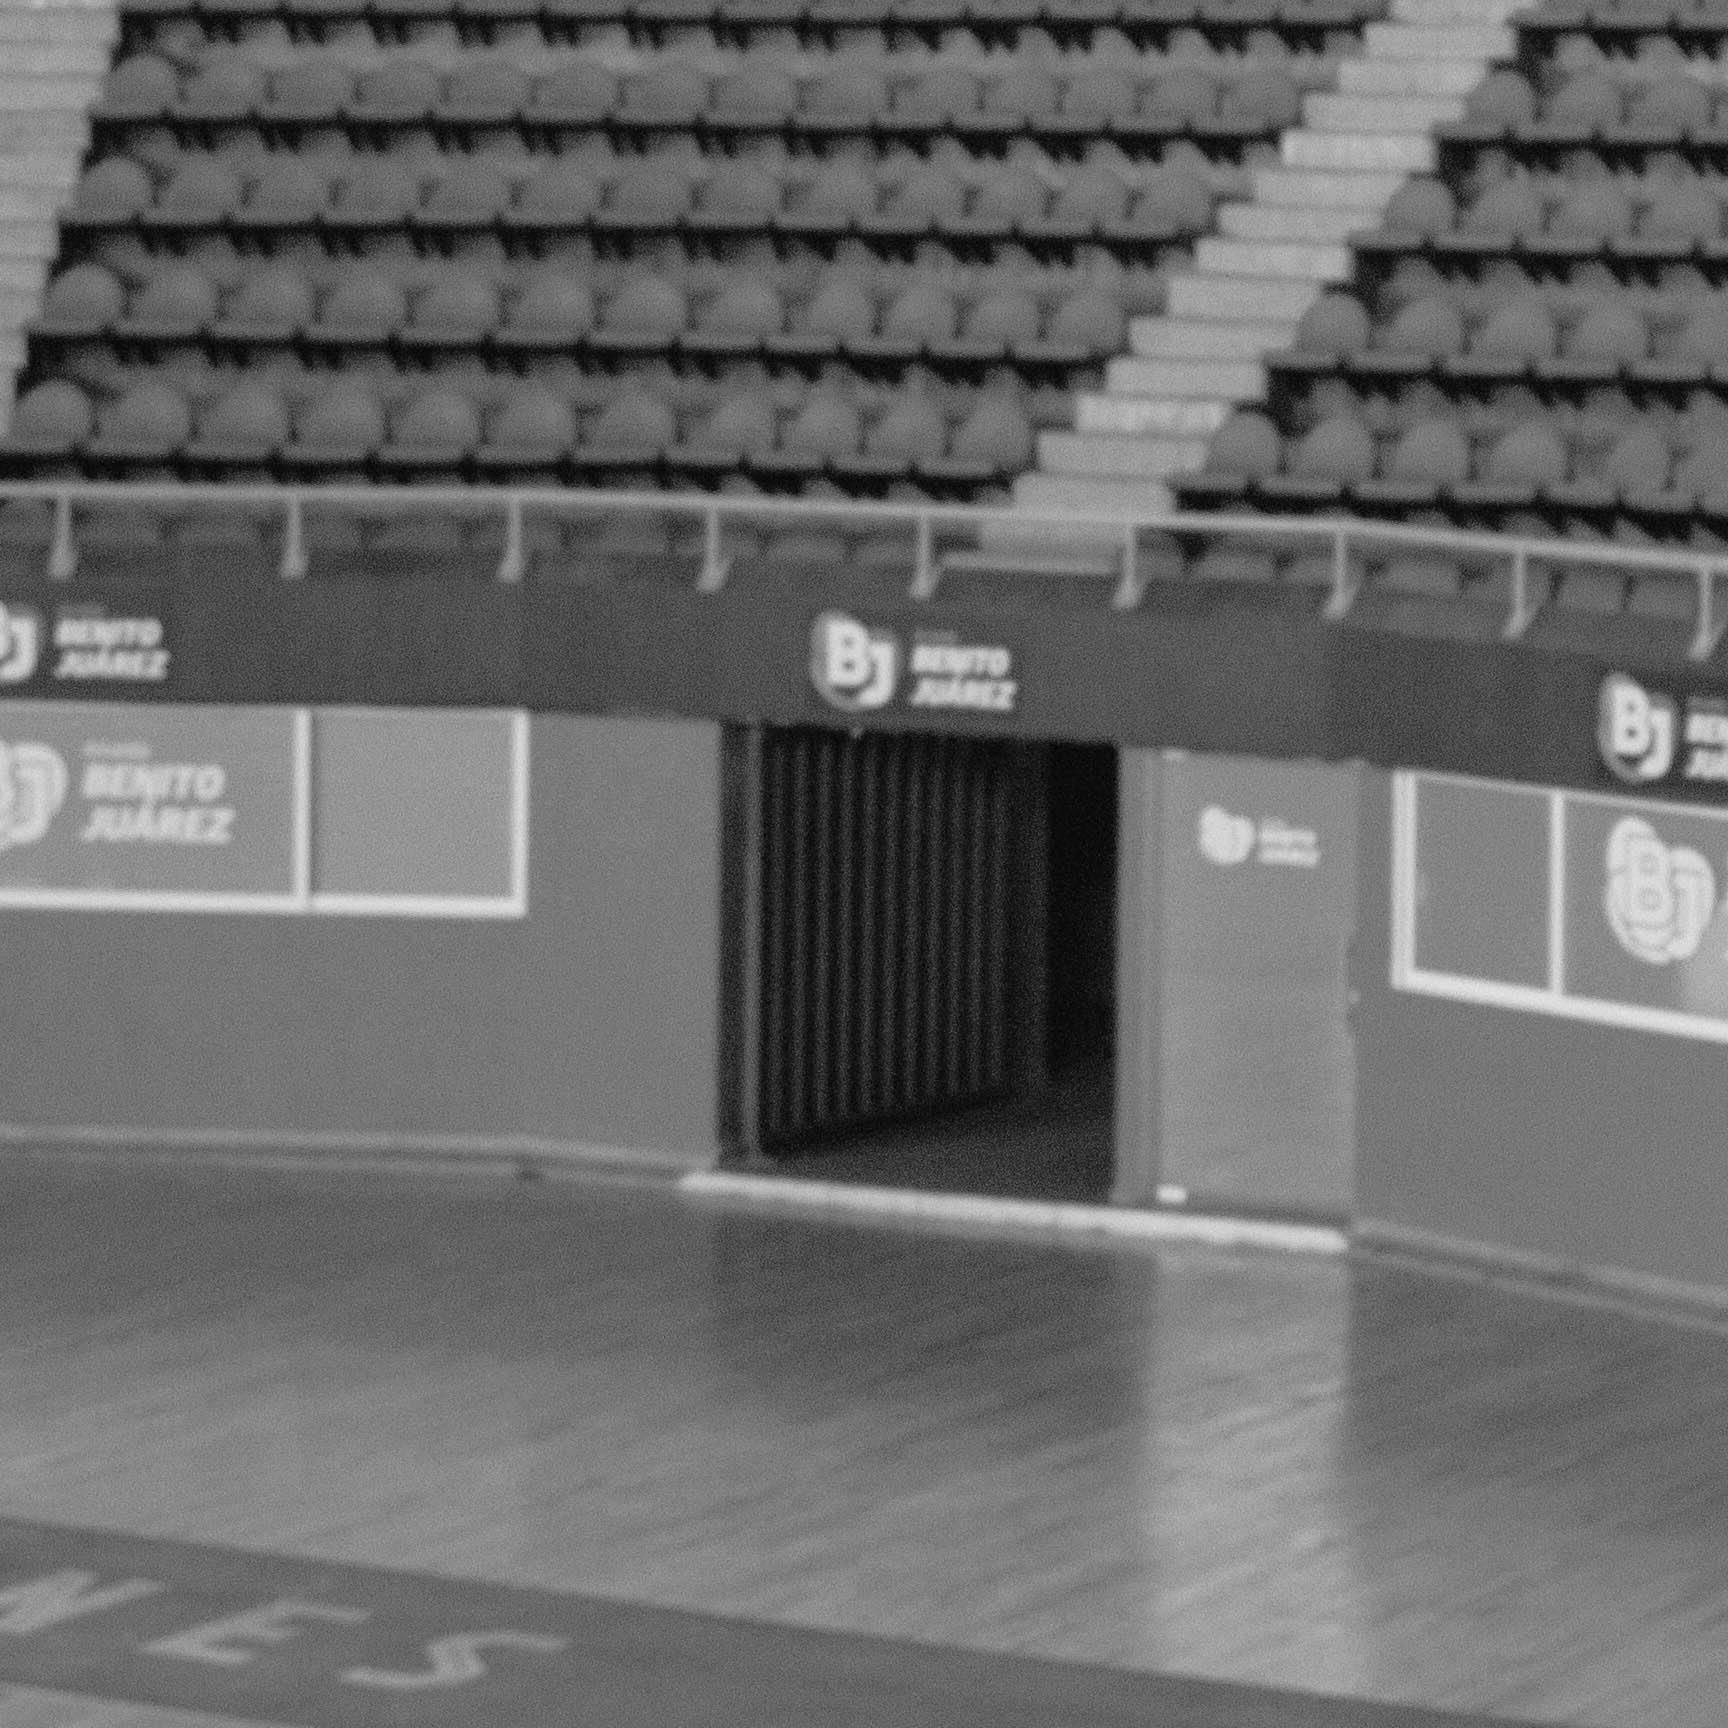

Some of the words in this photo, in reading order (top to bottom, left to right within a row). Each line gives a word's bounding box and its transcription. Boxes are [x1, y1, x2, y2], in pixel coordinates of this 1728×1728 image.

[826, 619, 895, 706] BJ
[1612, 682, 1674, 779] BJ
[82, 763, 226, 800] BENITO
[82, 798, 236, 845] JUÁREZ
